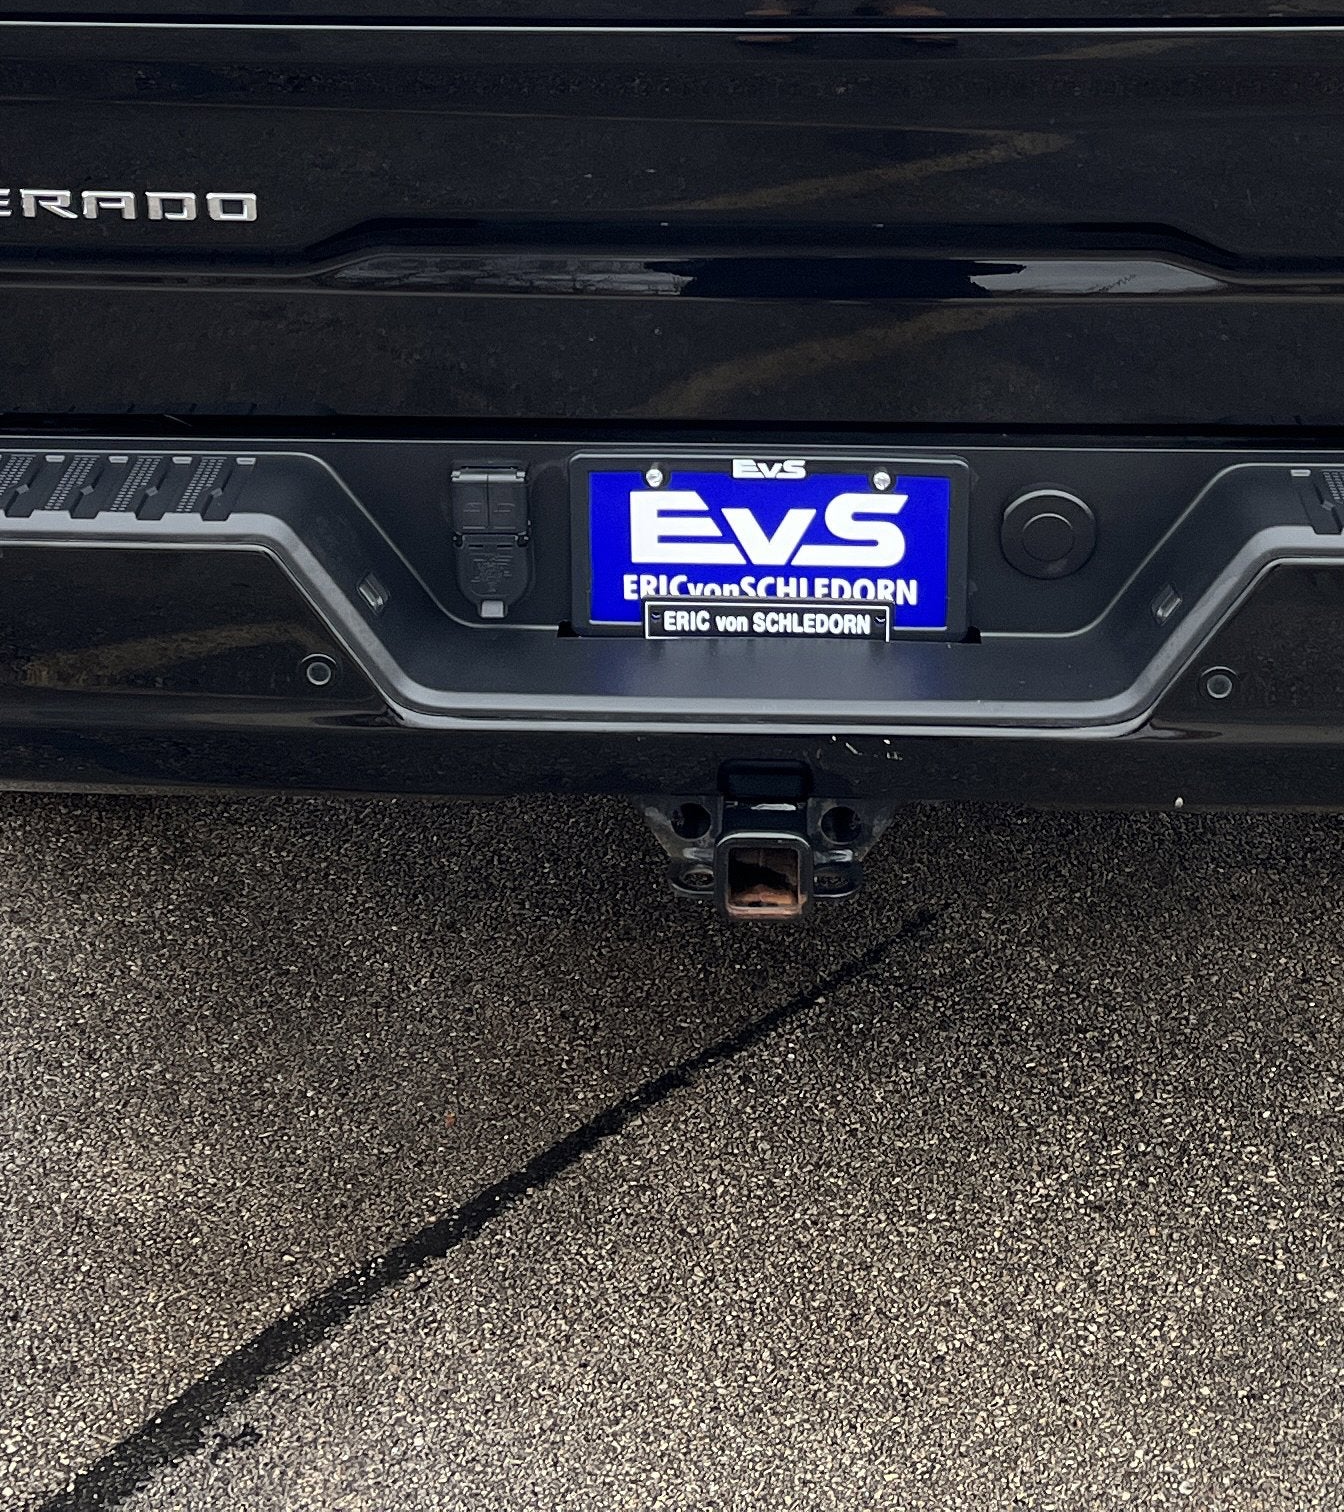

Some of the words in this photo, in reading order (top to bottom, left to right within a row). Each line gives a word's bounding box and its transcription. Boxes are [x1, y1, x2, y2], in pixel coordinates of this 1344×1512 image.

[663, 610, 710, 631] ERIC
[715, 614, 749, 632] von
[752, 612, 871, 635] SCHLEDORN
